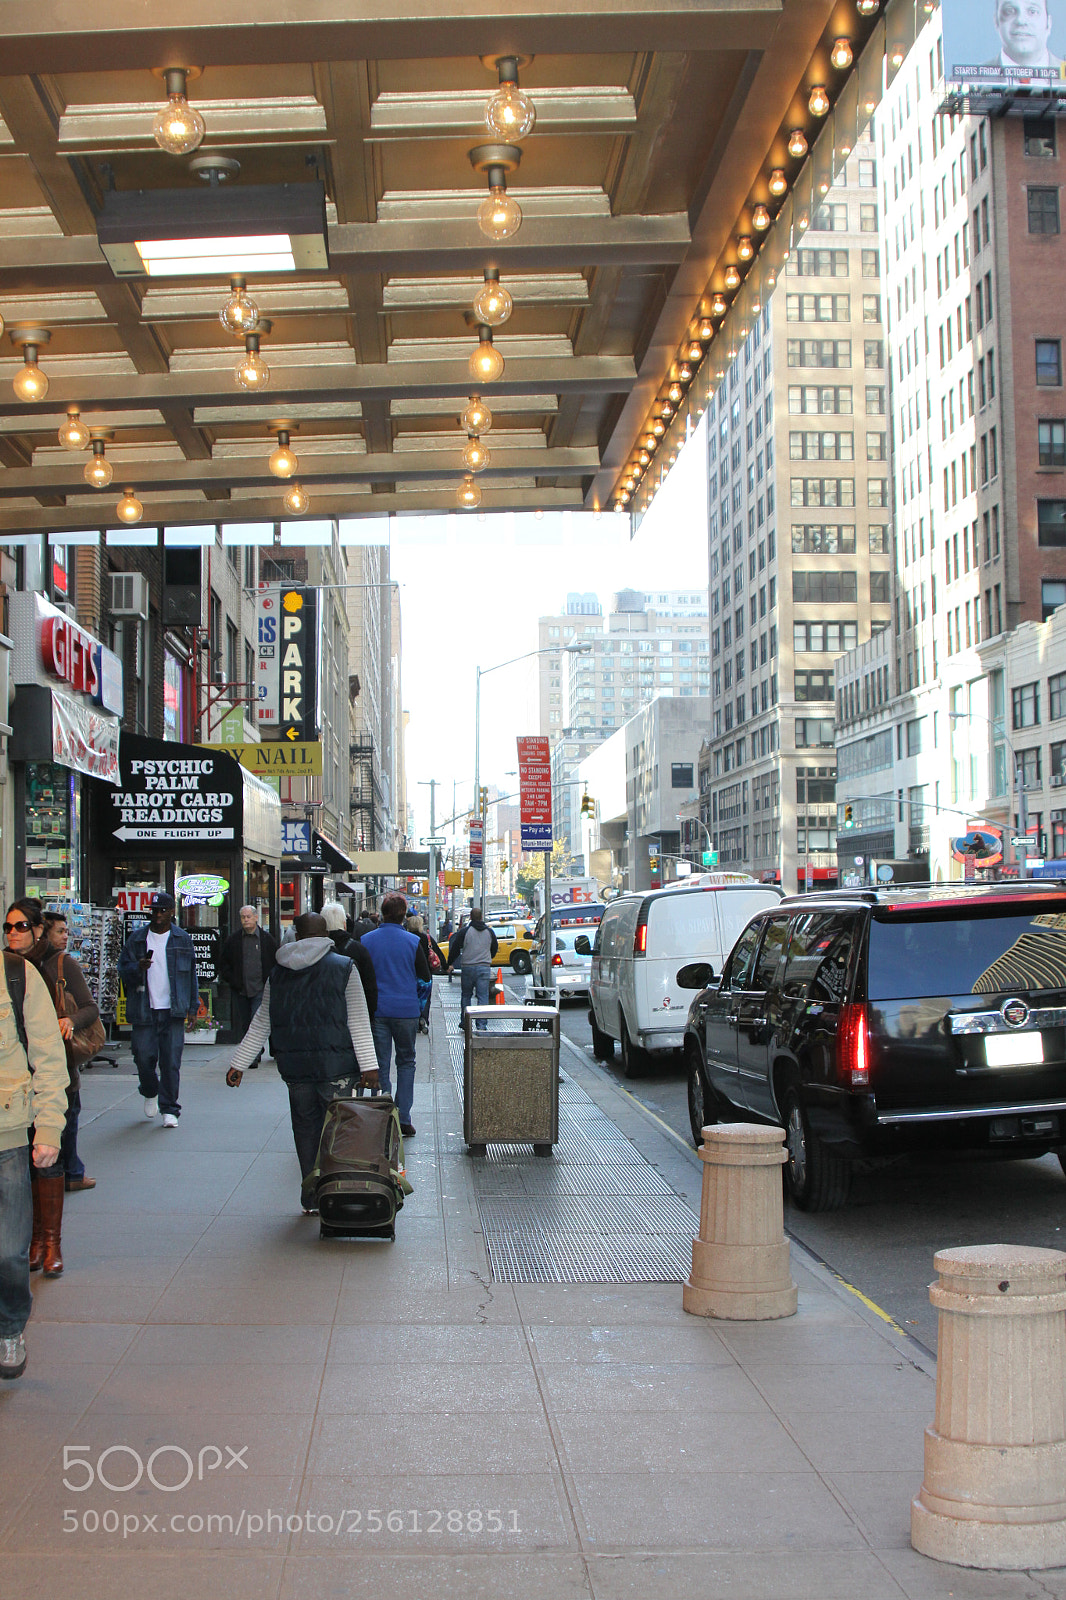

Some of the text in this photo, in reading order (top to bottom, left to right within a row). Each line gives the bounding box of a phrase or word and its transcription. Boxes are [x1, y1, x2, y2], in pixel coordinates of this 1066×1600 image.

[954, 67, 978, 75] STARTS
[979, 67, 1004, 76] FRIDAY,
[1005, 68, 1033, 77] OCTOBER
[42, 616, 99, 697] GIFTS
[283, 616, 303, 721] PARK
[256, 748, 313, 765] NAIL
[131, 760, 214, 775] PSYCHIC
[145, 776, 199, 790] PALM
[111, 793, 234, 807] TAROT CARD
[120, 808, 223, 823] READINGS
[551, 887, 594, 904] edEx
[196, 969, 215, 978] dings
